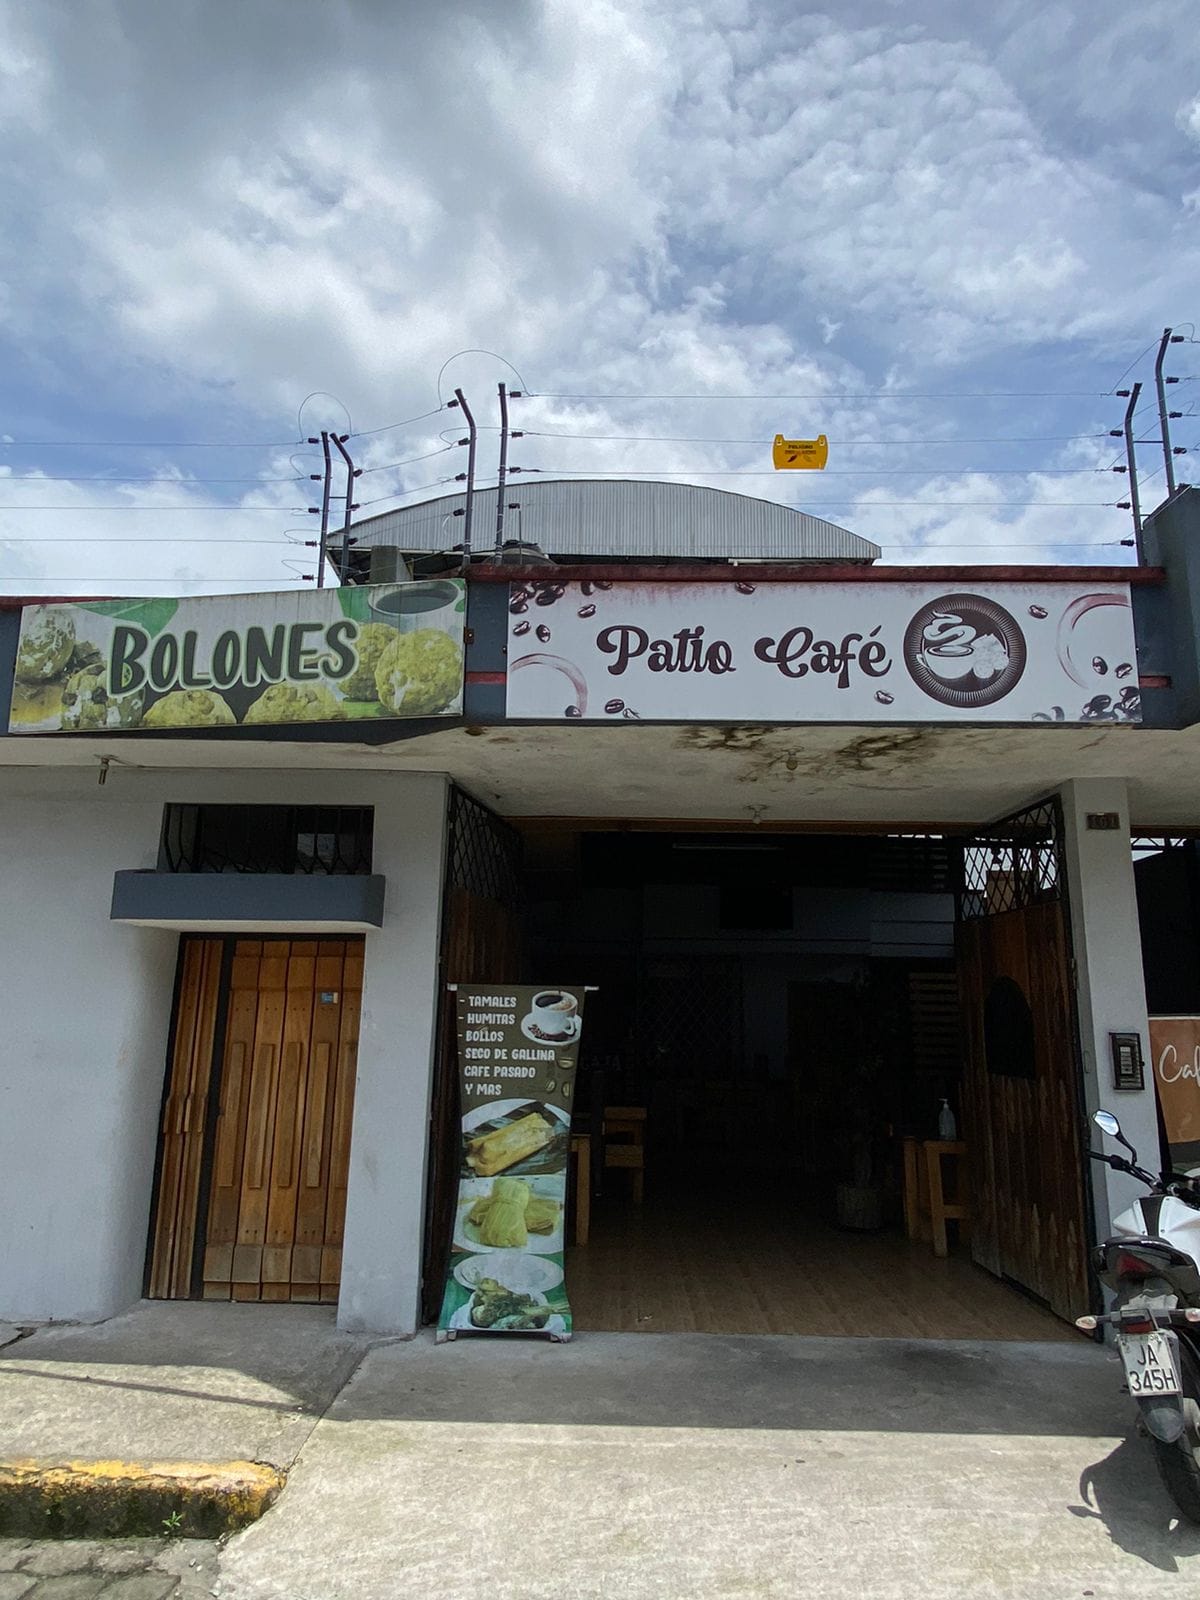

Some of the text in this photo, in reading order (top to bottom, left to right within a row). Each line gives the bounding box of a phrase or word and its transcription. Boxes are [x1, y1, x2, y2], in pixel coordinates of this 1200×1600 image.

[109, 619, 359, 696] BOLONES
[597, 625, 893, 689] Patio Café
[468, 996, 517, 1008] TAMALES
[467, 1013, 516, 1025] HUMITAS
[465, 1029, 505, 1042] BOLLOS
[464, 1048, 555, 1061] SECO DE GALLINA
[464, 1066, 536, 1078] CAFE PASADO
[464, 1083, 502, 1096] Y MAS
[1137, 1344, 1159, 1366] JA
[1129, 1369, 1177, 1392] 345H
